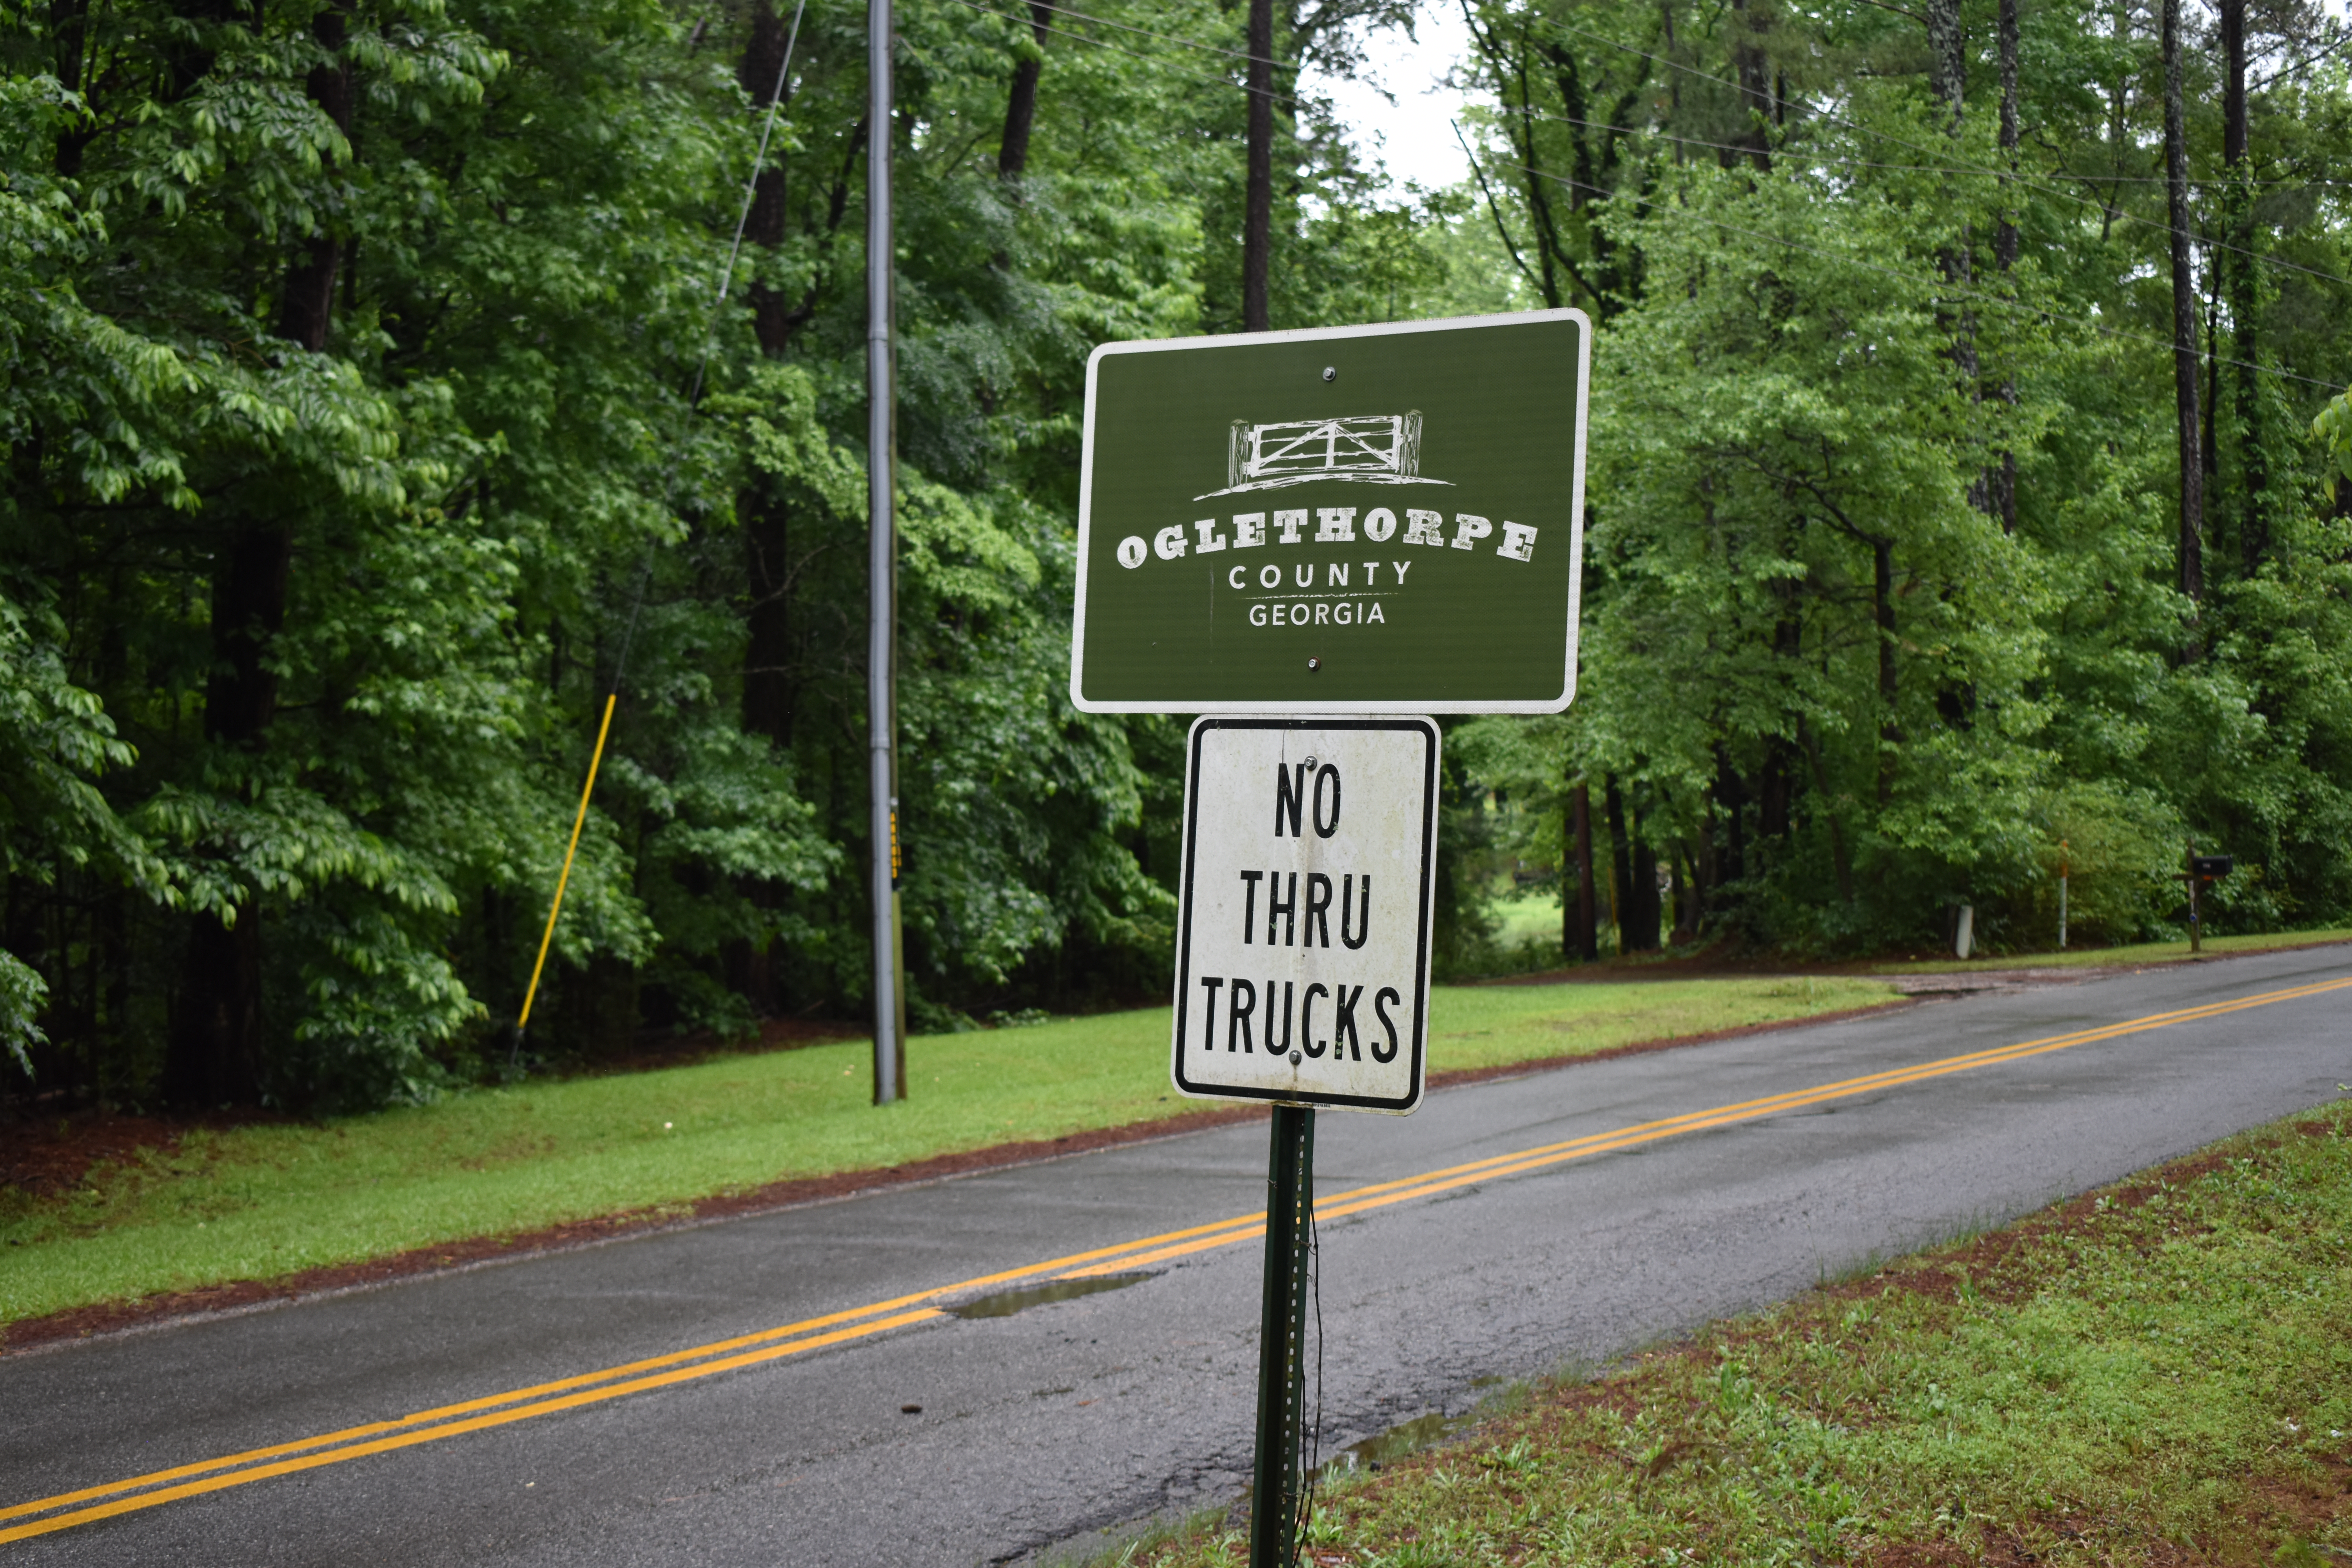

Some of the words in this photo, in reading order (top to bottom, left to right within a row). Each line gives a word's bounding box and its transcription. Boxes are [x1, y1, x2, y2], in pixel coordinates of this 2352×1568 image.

[1116, 507, 1538, 569] OGLETHORPE
[1229, 561, 1411, 589] COUNTY
[1250, 602, 1385, 626] GEORGIA
[1275, 763, 1341, 839] NO
[1240, 870, 1370, 950] THRU
[1201, 976, 1400, 1063] TRUCKS
